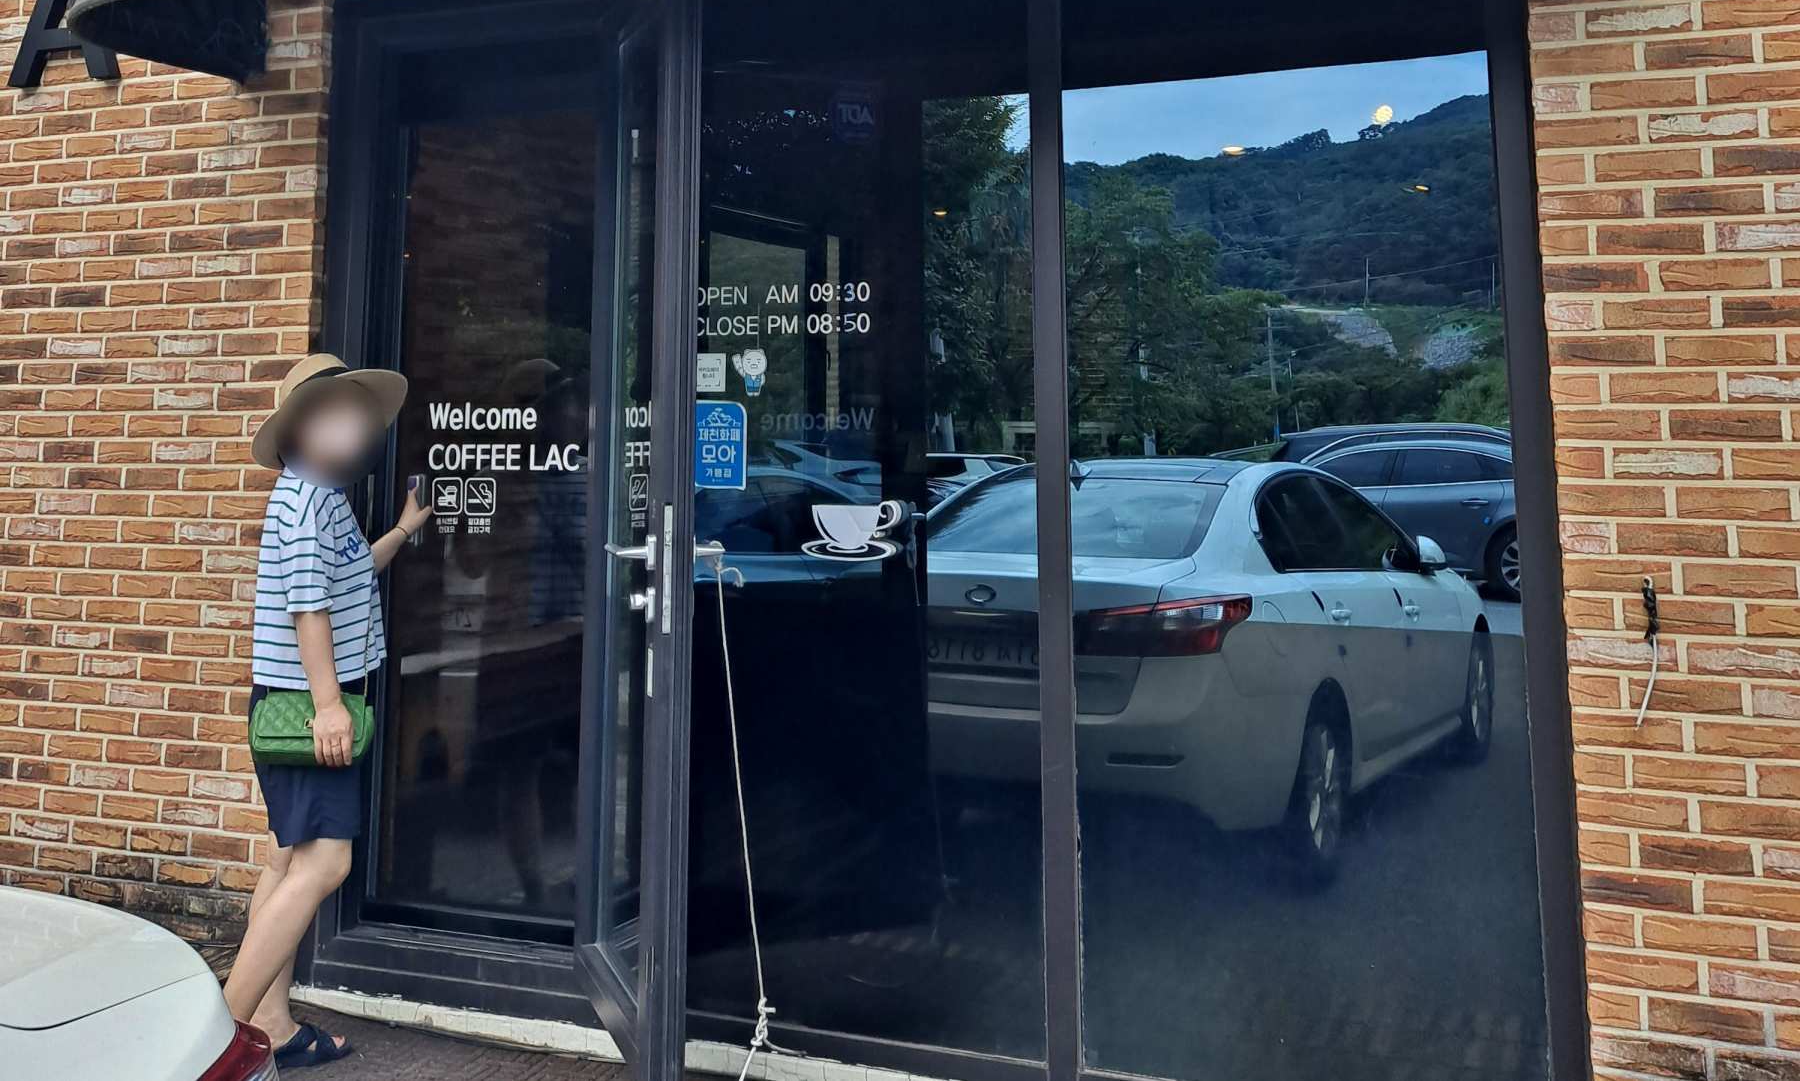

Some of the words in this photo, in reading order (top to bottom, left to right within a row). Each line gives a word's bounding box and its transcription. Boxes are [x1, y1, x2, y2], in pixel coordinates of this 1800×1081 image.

[698, 286, 748, 306] OPEN
[765, 285, 799, 304] AM
[809, 281, 871, 302] 09:30
[767, 315, 799, 335] PM
[807, 312, 871, 334] 08:50
[429, 402, 538, 430] Welcome
[428, 443, 521, 471] COFFEE
[529, 443, 580, 471] LAC
[701, 444, 736, 463] 모아
